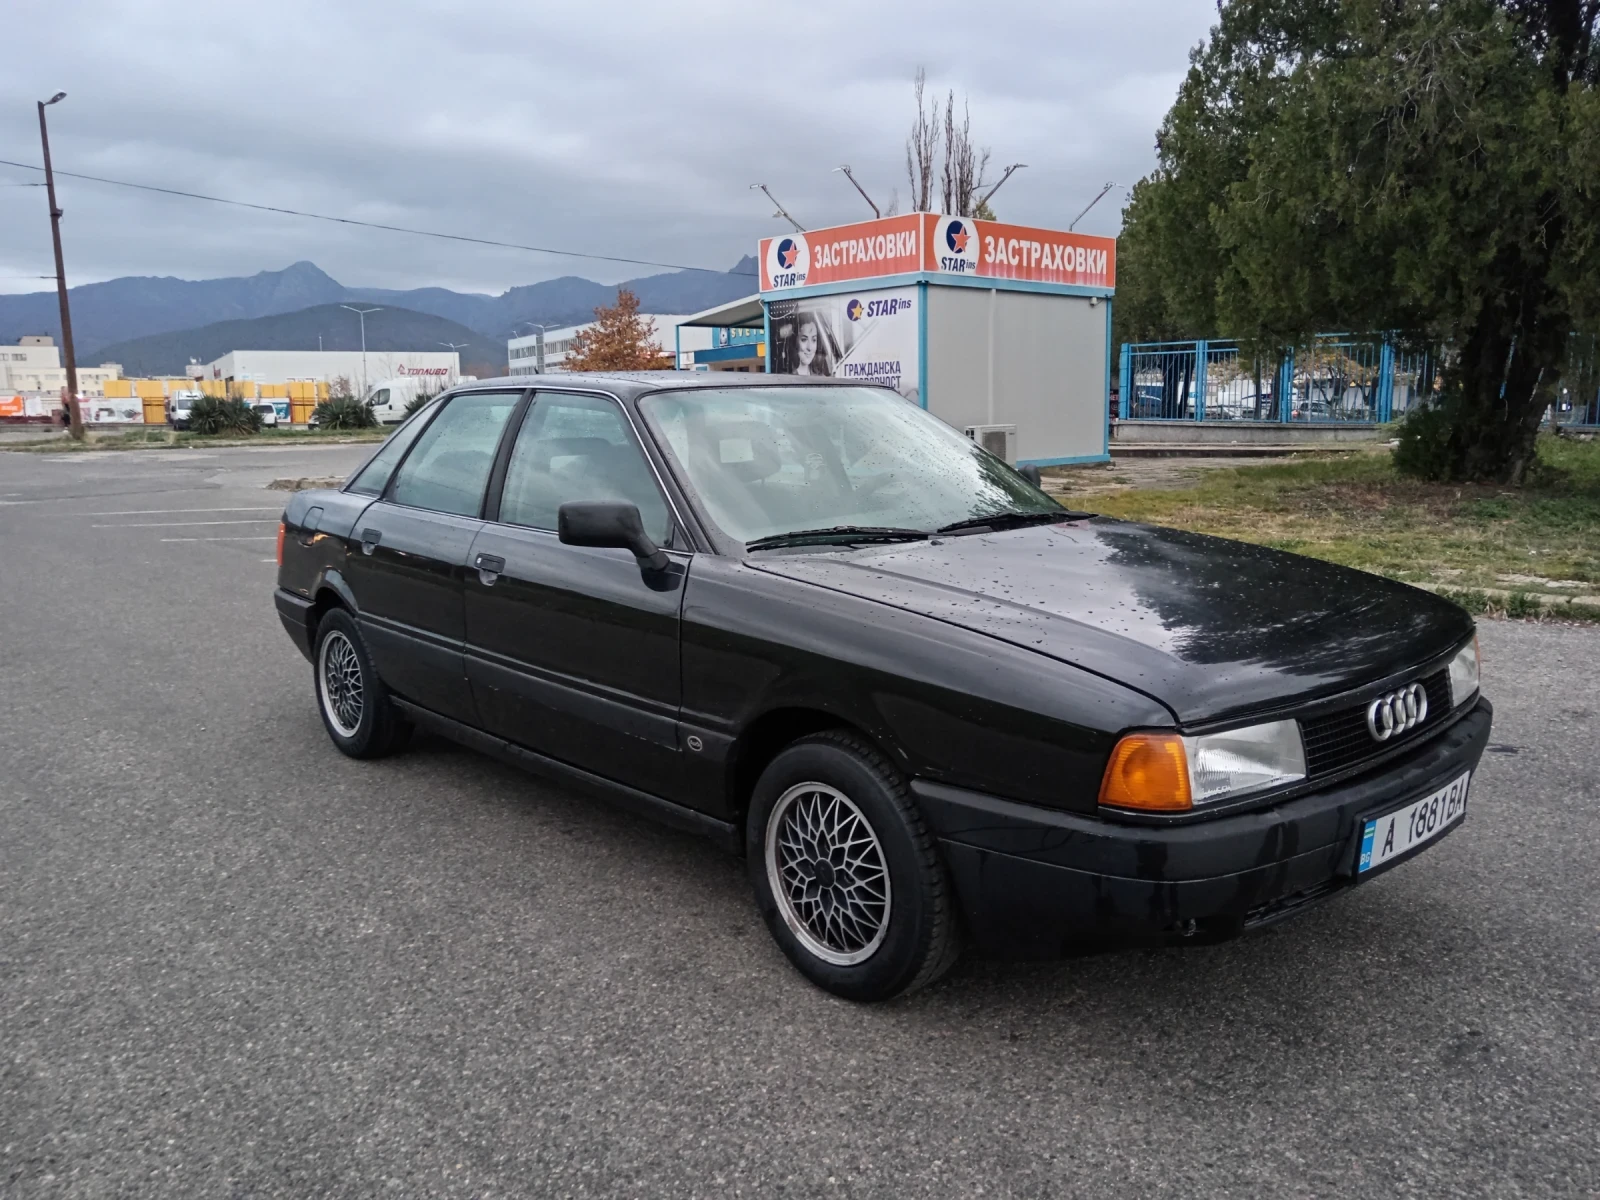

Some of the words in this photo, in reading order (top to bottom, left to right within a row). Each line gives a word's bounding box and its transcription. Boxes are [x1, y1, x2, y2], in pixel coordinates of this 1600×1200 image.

[814, 230, 916, 269] ЗАСТРАХОВКИ
[984, 235, 1107, 275] ЗАСТРАХОВКИ
[941, 256, 965, 272] STAR
[773, 273, 796, 288] STAR
[867, 299, 898, 318] STAR
[844, 361, 901, 377] ГРАЖДАНСКА
[1360, 851, 1371, 866] BG
